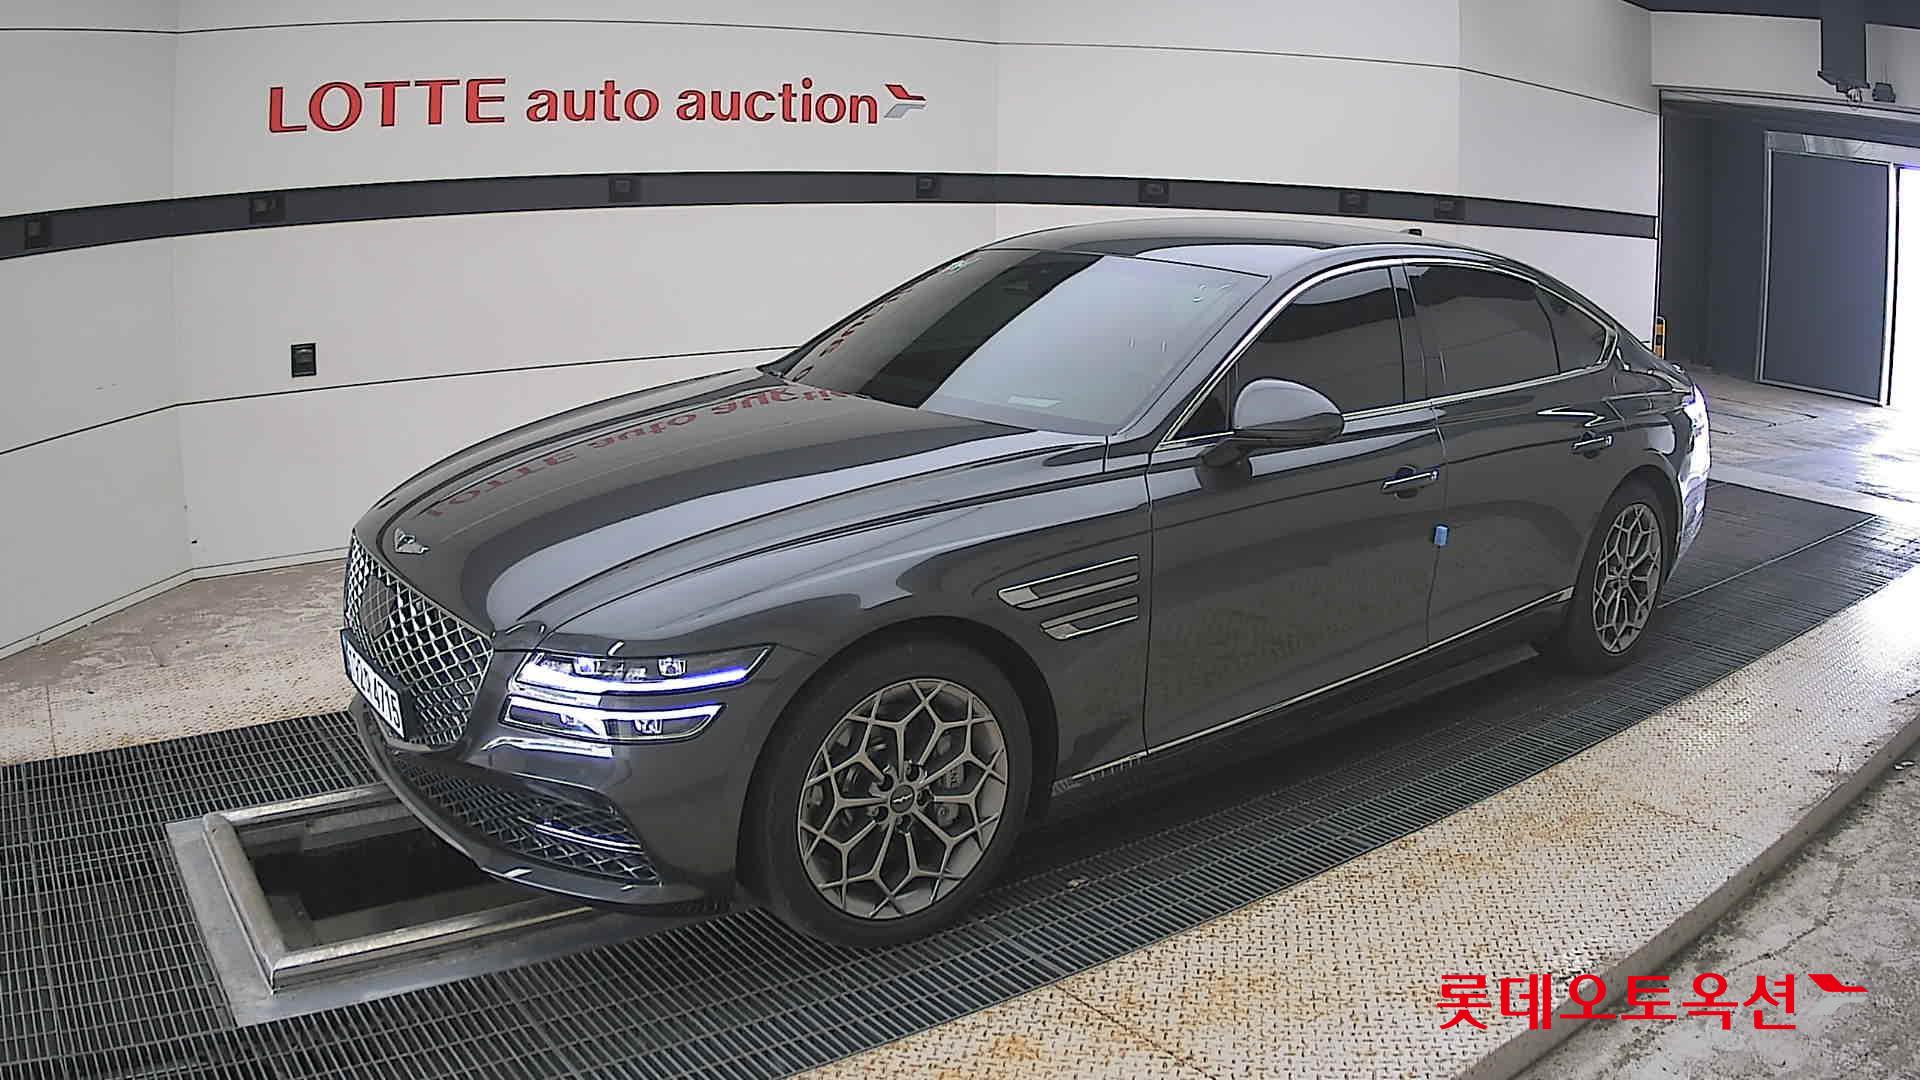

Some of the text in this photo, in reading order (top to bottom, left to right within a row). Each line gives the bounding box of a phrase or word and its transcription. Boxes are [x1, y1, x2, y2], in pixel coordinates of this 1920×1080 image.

[268, 78, 879, 133] LOTTE auto auction
